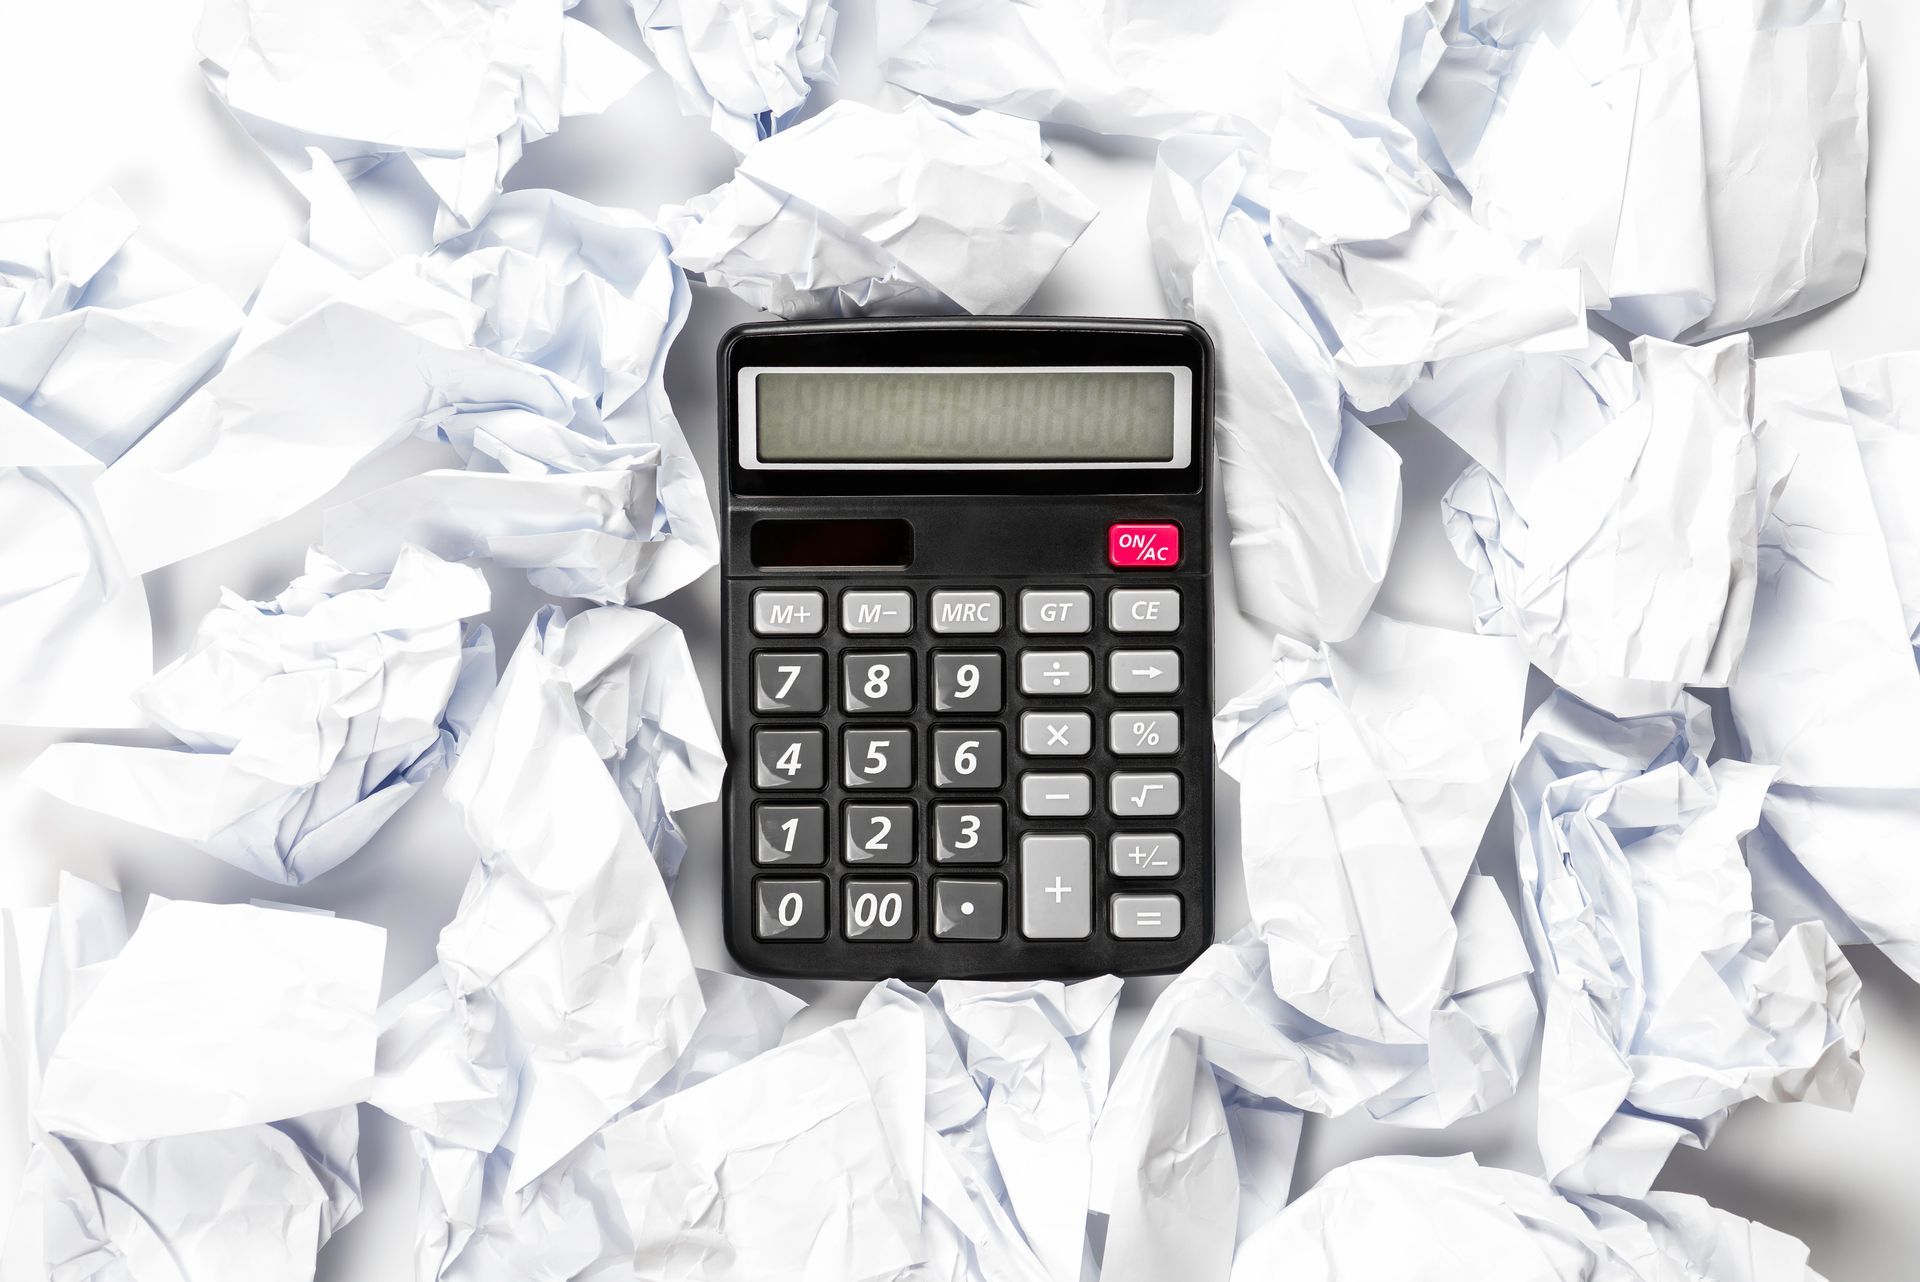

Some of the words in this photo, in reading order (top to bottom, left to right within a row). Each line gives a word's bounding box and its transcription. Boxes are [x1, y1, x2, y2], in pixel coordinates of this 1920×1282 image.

[770, 606, 810, 623] M+
[942, 603, 990, 621] MRC
[1041, 603, 1072, 621] GT
[1132, 601, 1160, 619] CE
[776, 666, 801, 698] 7
[864, 665, 889, 698] 8
[955, 665, 979, 698] 9
[1133, 722, 1159, 745] %
[776, 743, 801, 775] 4
[864, 741, 889, 773] 5
[955, 741, 979, 774] 6
[782, 819, 798, 851] 1
[865, 817, 891, 849] 2
[955, 815, 980, 848] 3
[779, 893, 802, 926] 0
[855, 893, 901, 927] 00
